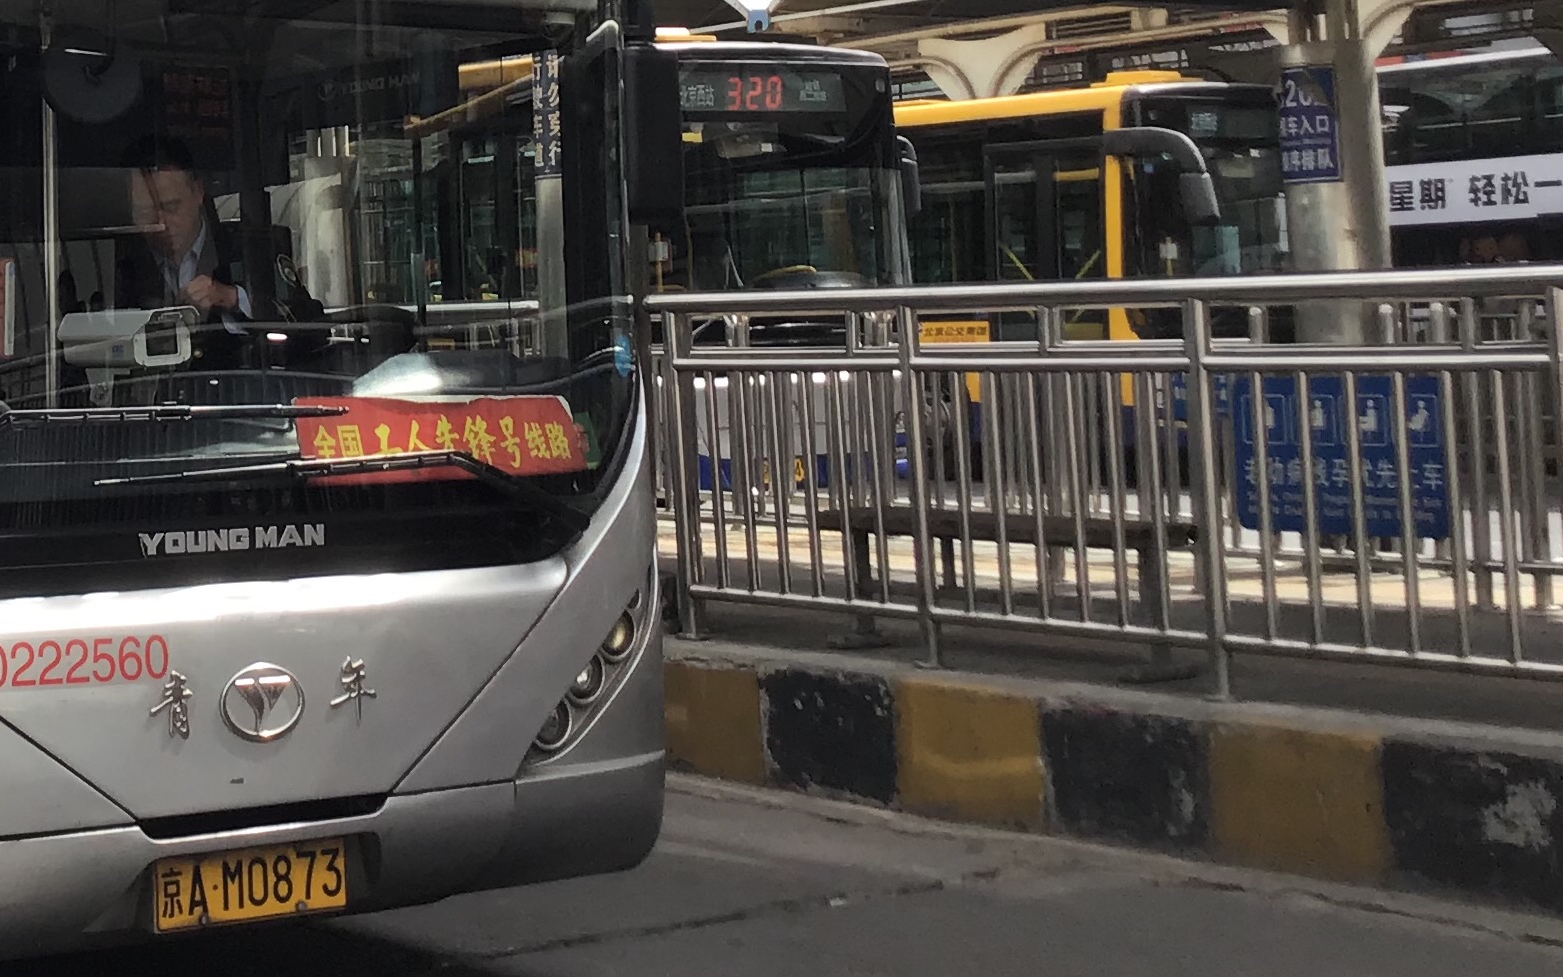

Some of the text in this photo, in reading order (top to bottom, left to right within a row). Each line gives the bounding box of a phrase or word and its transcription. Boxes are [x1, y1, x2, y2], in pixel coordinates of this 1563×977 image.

[727, 74, 783, 111] 320
[1389, 177, 1447, 212] 星期
[139, 523, 326, 557] YOUNG MAN
